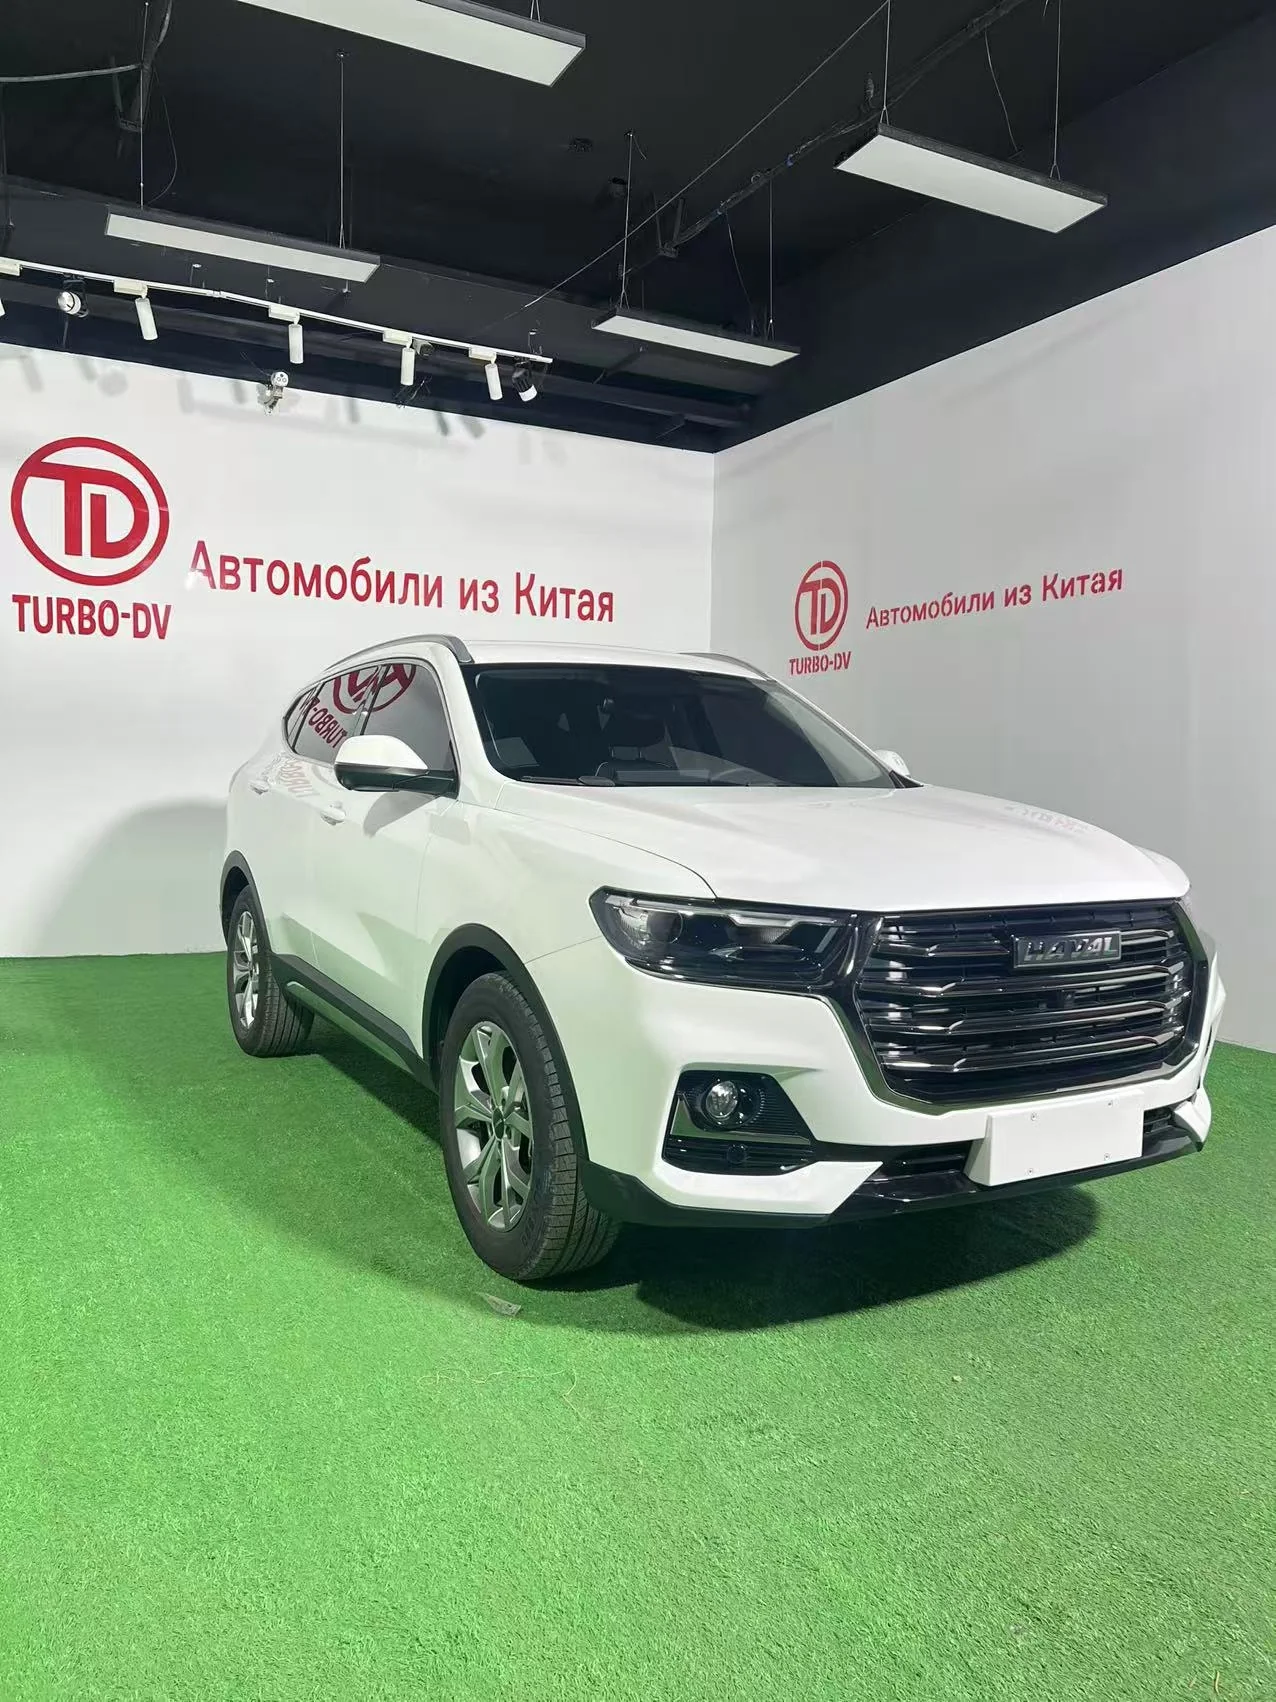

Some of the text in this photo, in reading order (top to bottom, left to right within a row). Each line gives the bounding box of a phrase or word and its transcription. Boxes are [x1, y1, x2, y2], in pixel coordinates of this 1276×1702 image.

[189, 540, 614, 623] Автомобили из Китая
[866, 568, 1123, 630] Автомобили из Китая
[11, 594, 171, 640] TURBO-DV
[789, 651, 852, 676] TURBO-DV
